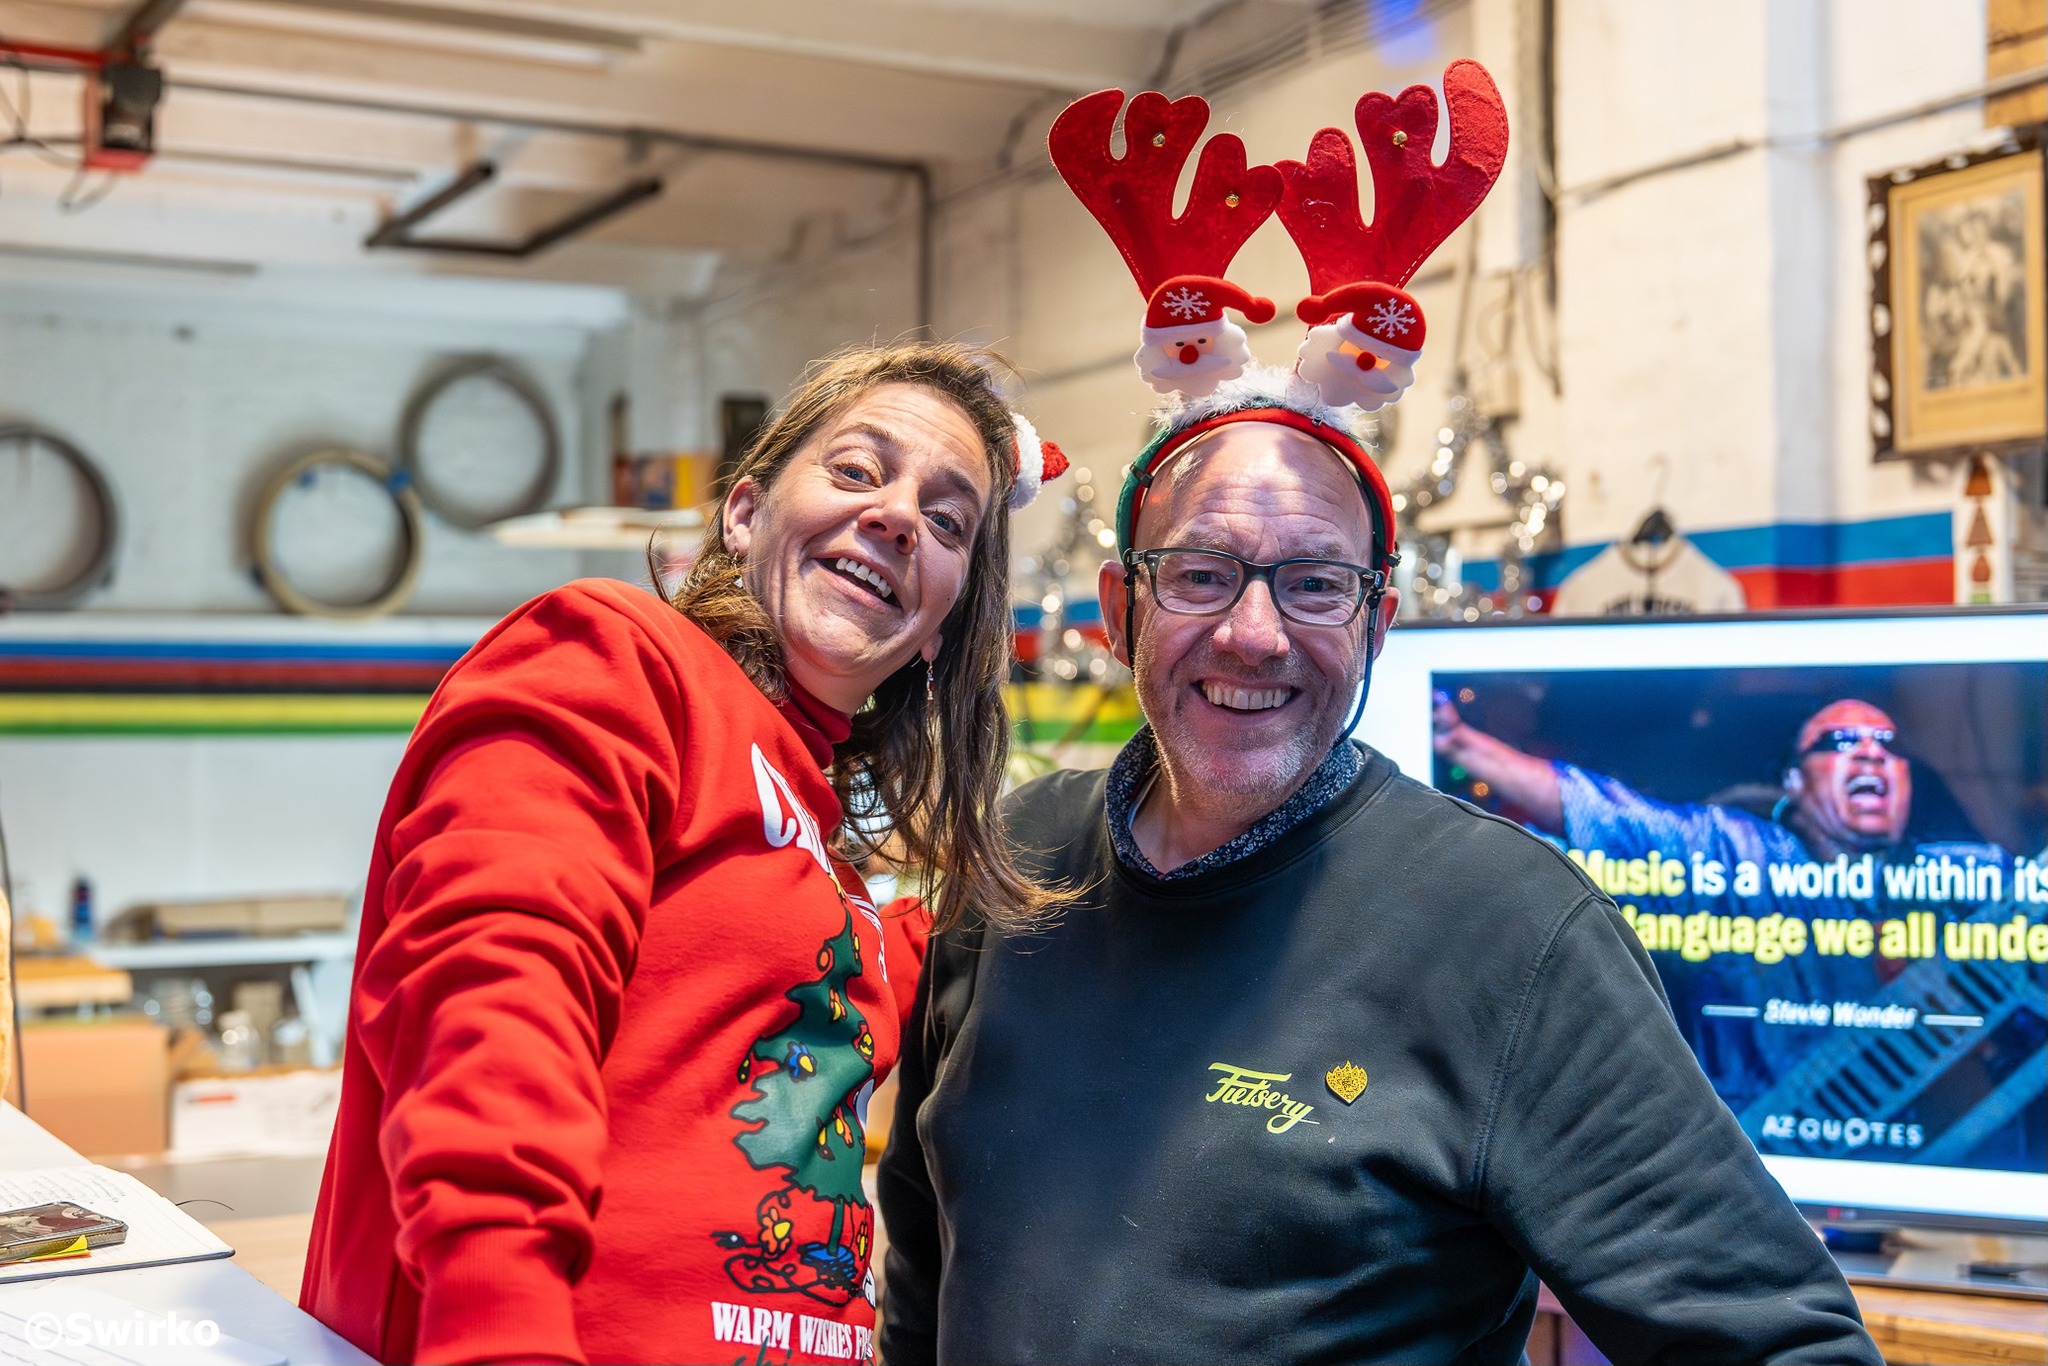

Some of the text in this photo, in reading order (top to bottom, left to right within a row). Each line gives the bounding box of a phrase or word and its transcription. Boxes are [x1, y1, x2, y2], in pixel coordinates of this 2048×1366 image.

[1566, 849, 1686, 896] Music
[1692, 852, 1726, 896] is
[1733, 860, 1761, 896] a
[1769, 853, 1874, 899] world
[1884, 855, 2002, 901] within
[1812, 918, 1875, 957] we
[1879, 911, 1936, 958] all
[1945, 914, 2048, 964] unde
[1764, 998, 1918, 1029] Stevie Wonder
[711, 1302, 794, 1350] WARM
[799, 1314, 853, 1360] WISHES
